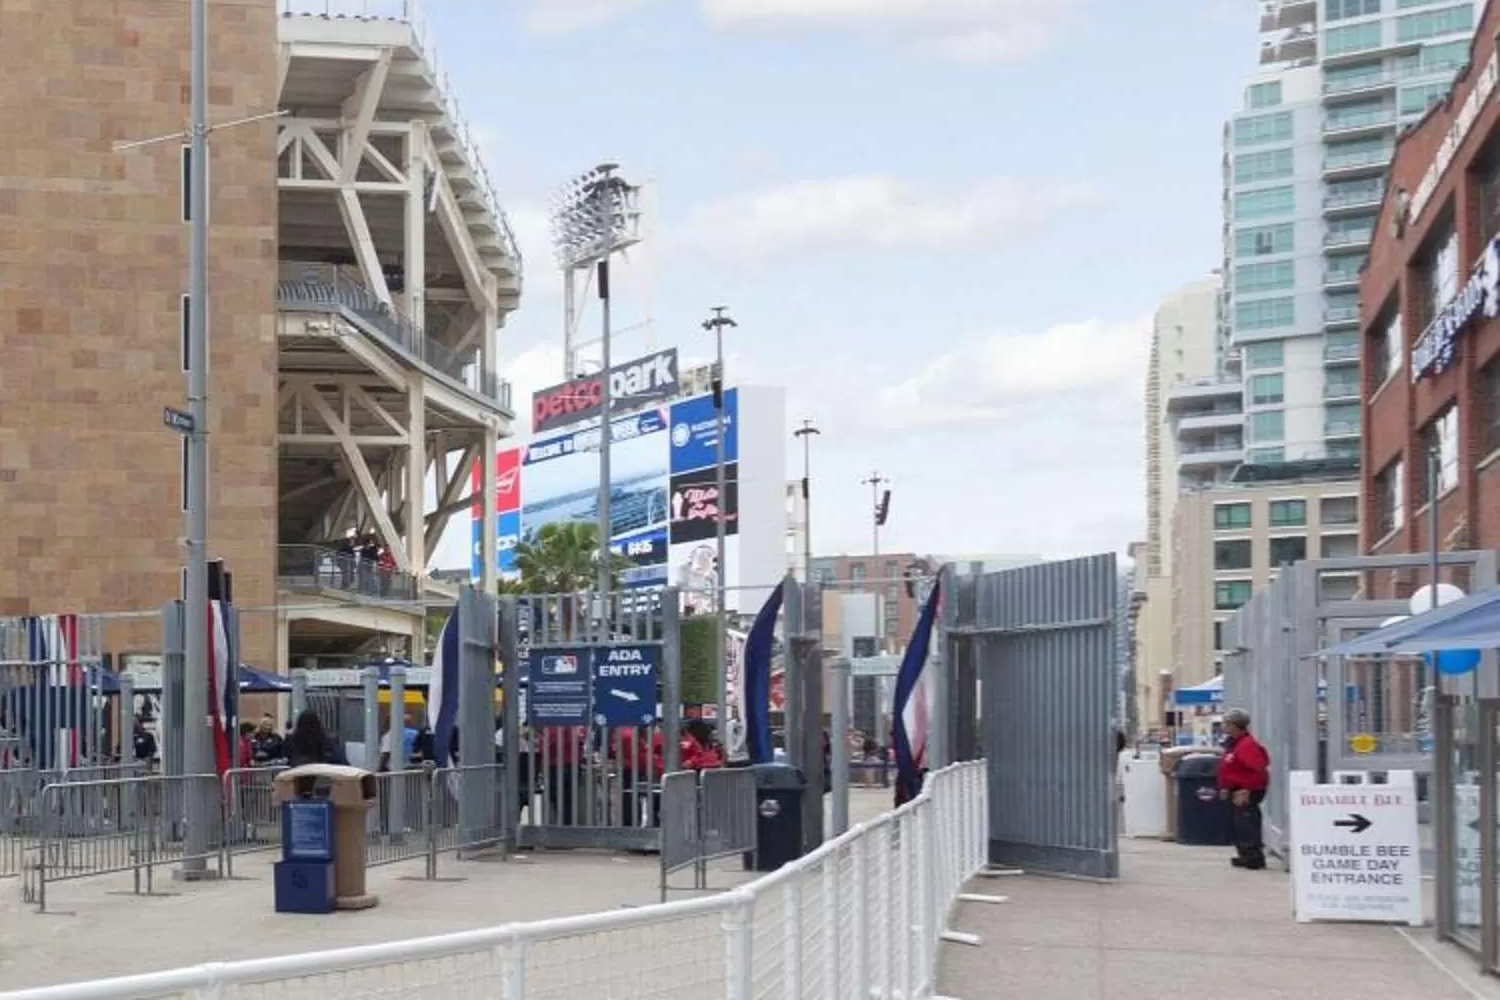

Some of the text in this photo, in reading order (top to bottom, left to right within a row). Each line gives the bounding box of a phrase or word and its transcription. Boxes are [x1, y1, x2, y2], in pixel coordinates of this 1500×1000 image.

[533, 354, 674, 425] petco park
[608, 649, 642, 661] ADA
[599, 663, 652, 677] ENTRY
[1300, 793, 1404, 807] BUMBLE BEE
[1300, 845, 1411, 857] BUMBLE BEE
[1312, 859, 1400, 871] GAME DAY
[1311, 873, 1403, 885] ENTRANCE
